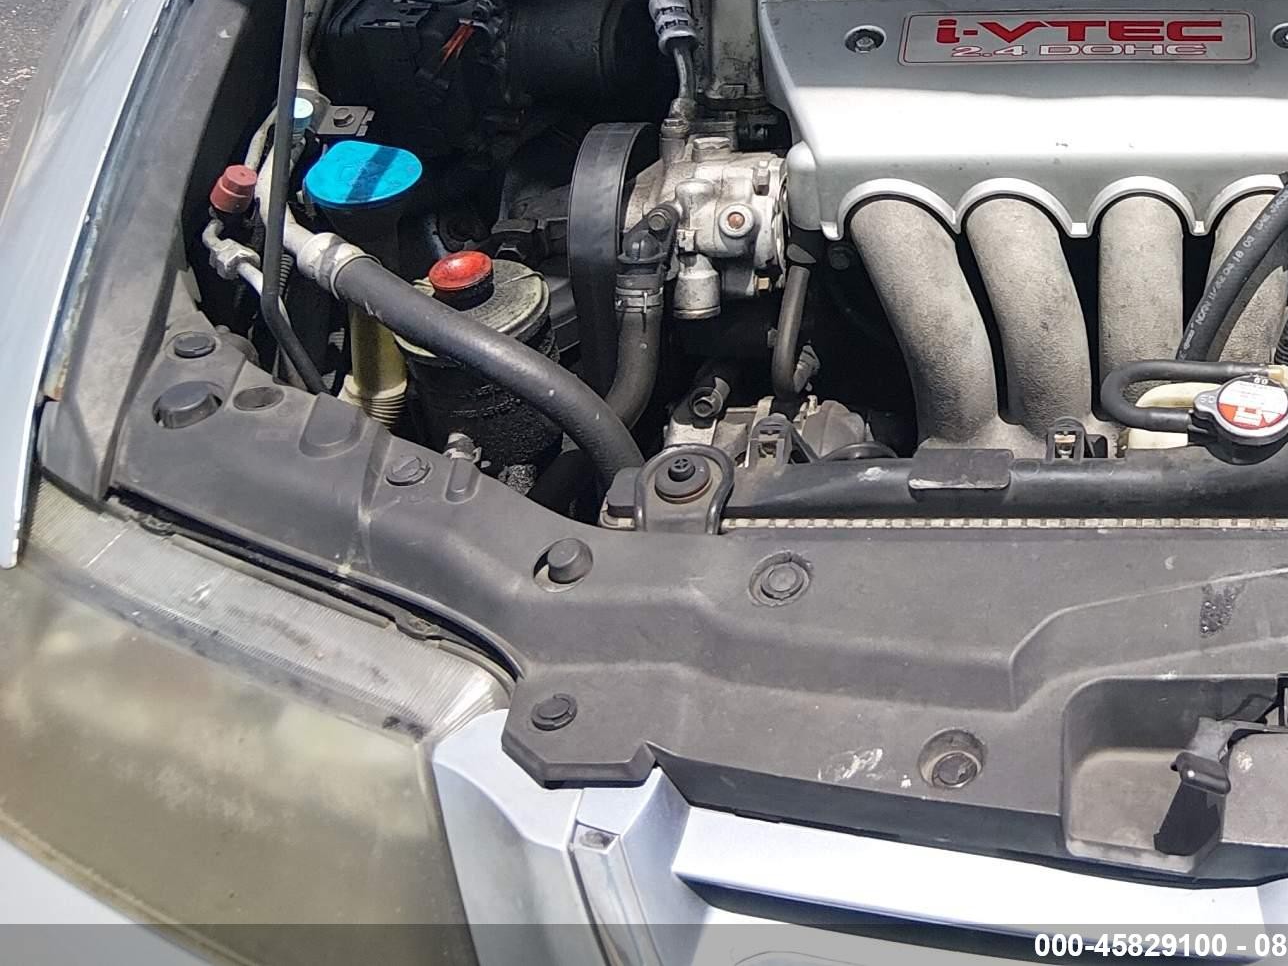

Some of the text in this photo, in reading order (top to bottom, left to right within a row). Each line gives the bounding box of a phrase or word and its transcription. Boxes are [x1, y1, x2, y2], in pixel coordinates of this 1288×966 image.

[936, 19, 1222, 44] i-VTEC
[952, 43, 1208, 57] 2.4 DOHC
